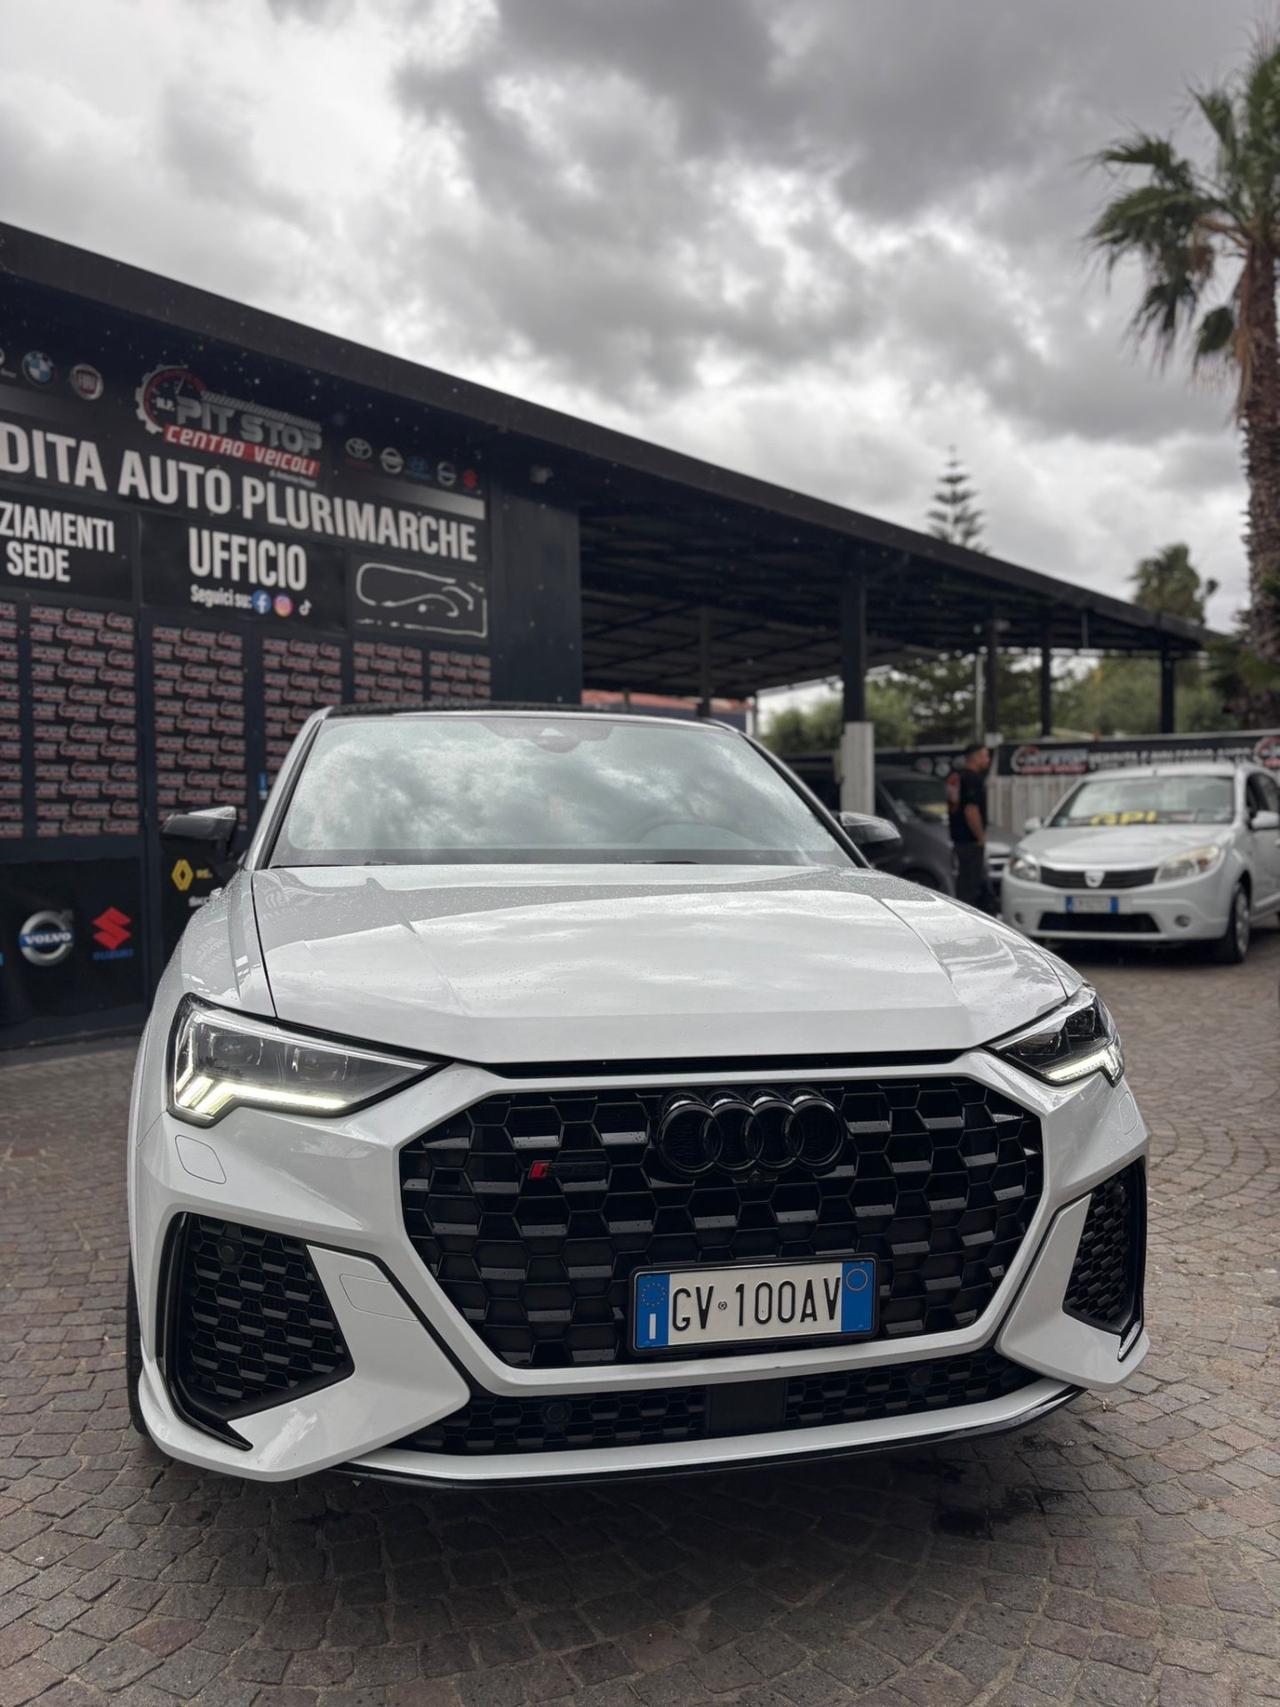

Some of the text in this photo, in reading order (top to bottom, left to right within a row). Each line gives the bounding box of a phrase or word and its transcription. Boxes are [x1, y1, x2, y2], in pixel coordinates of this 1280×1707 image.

[176, 395, 322, 455] PIT STOP
[0, 421, 478, 563] DITA AUTO PLURIMARCHE
[0, 501, 115, 553] ZIAMENTI
[6, 540, 71, 583] SEDE
[189, 527, 307, 591] UFFICIO
[190, 584, 234, 609] Seguici
[24, 931, 72, 945] VOLVO
[672, 1276, 841, 1331] GV 100AV
